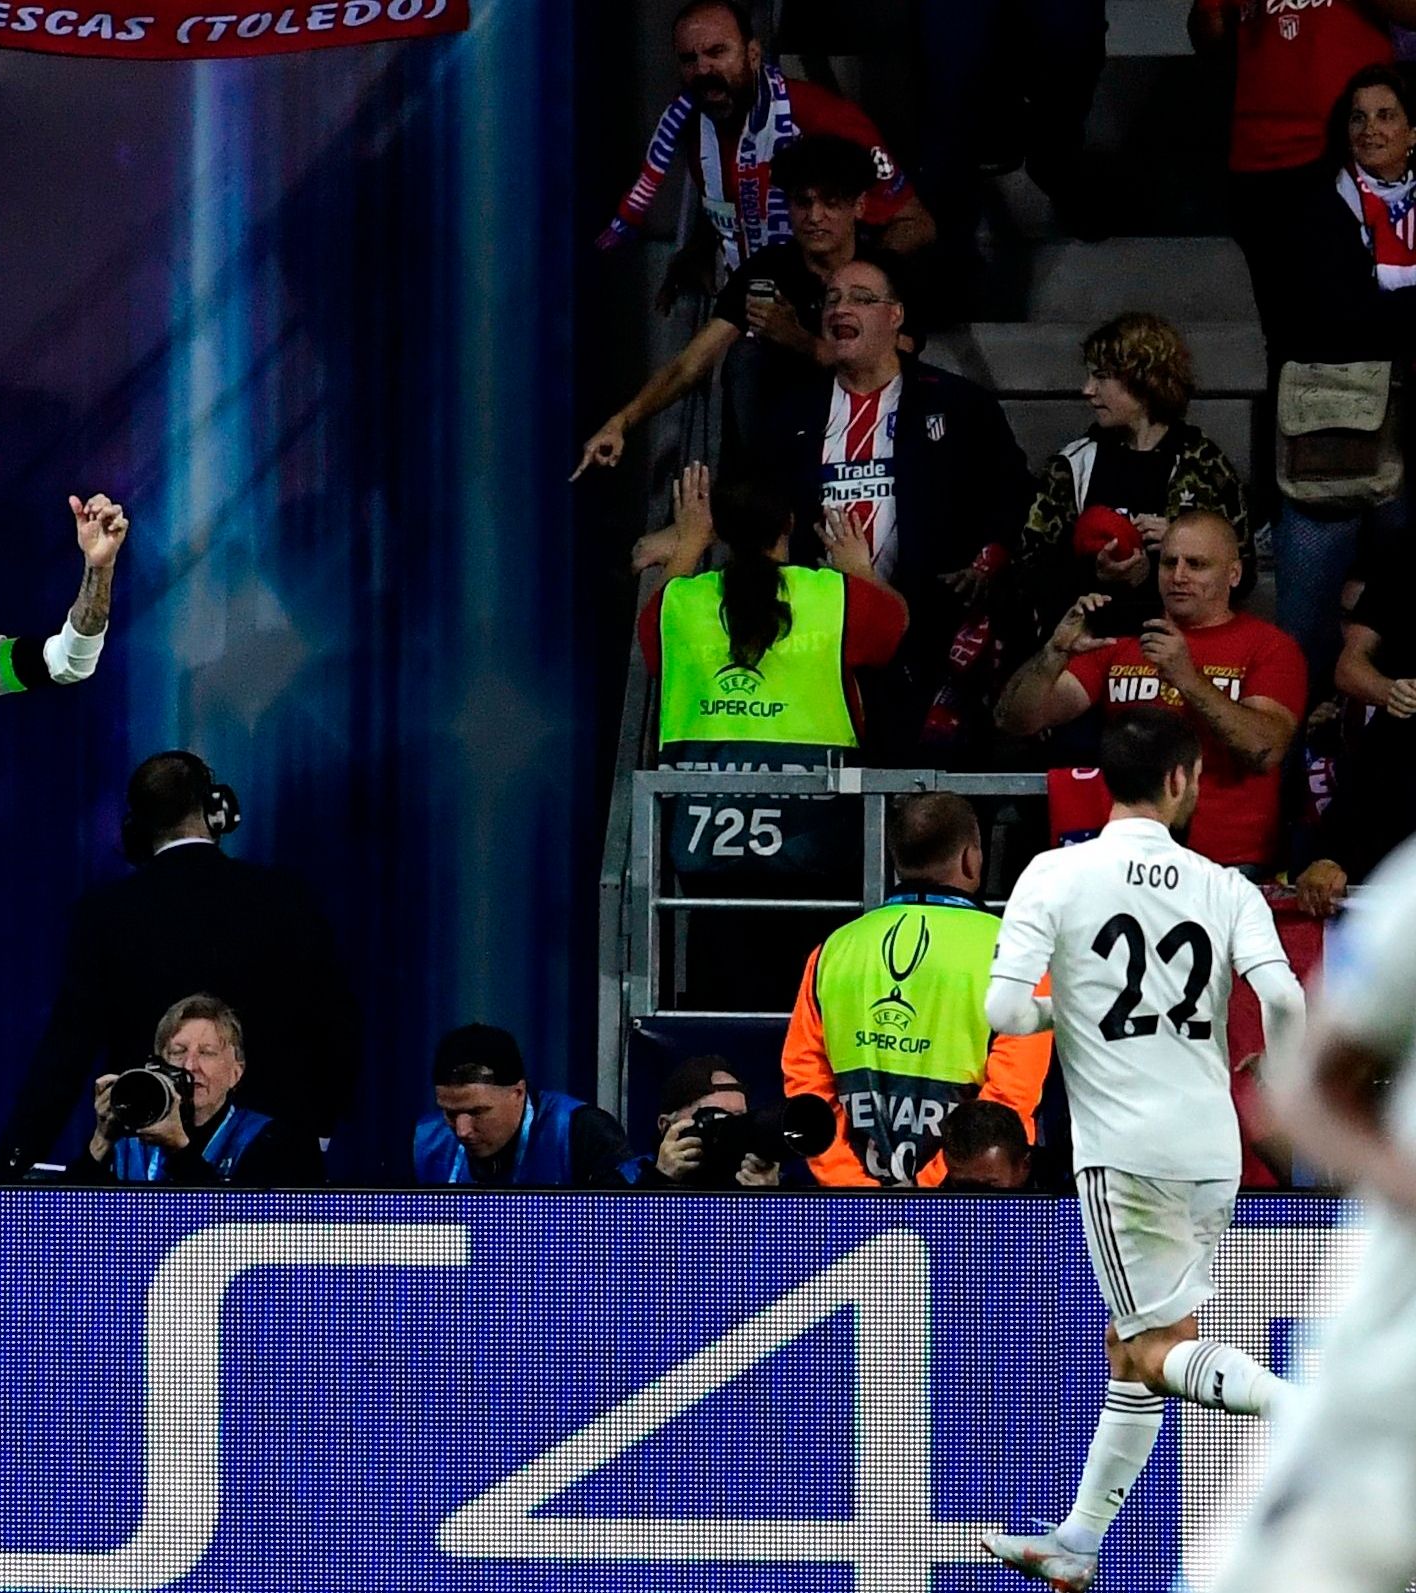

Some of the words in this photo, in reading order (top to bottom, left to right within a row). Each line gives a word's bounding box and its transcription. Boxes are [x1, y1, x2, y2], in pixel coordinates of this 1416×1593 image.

[176, 0, 449, 44] (TOLEDO)
[834, 460, 886, 480] Trade
[720, 677, 756, 694] UEFA
[699, 699, 747, 716] SUPER
[748, 700, 783, 717] CUP
[688, 805, 783, 857] 725
[1126, 860, 1179, 890] ISCO
[1091, 912, 1213, 1042] 22
[874, 1012, 909, 1031] UEFA
[855, 1031, 898, 1051] SUPER
[899, 1037, 931, 1054] CUP
